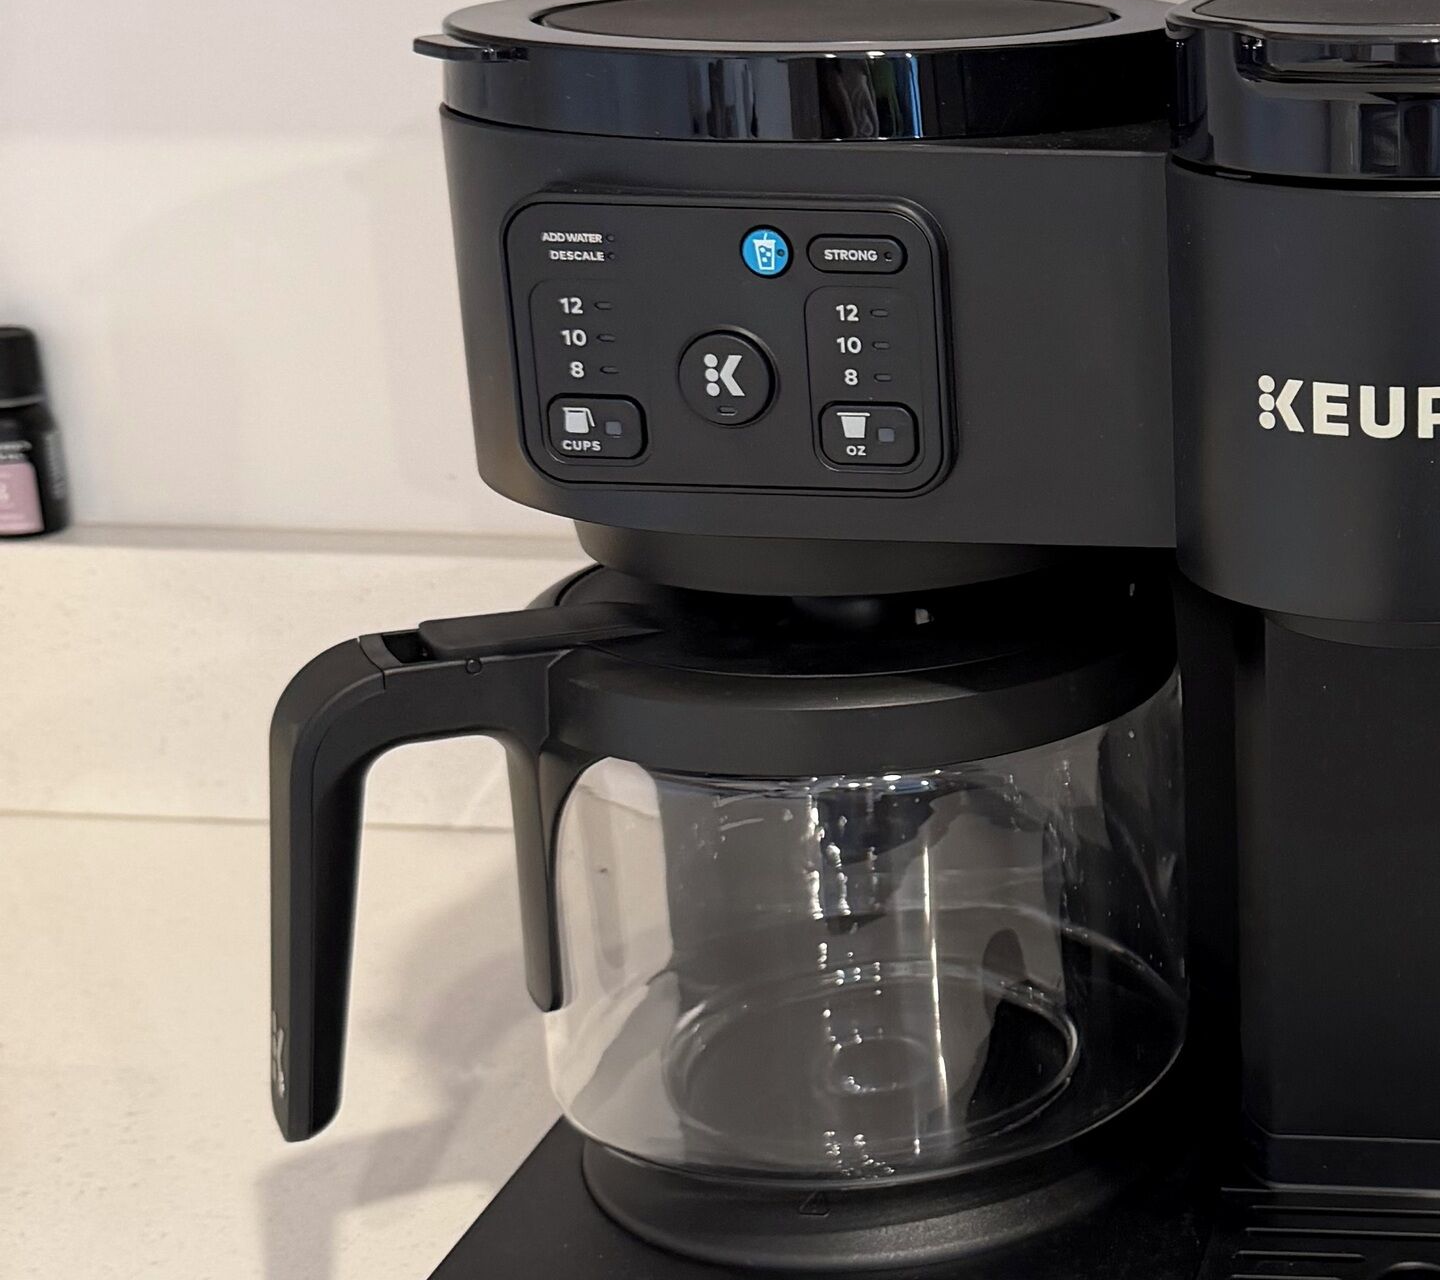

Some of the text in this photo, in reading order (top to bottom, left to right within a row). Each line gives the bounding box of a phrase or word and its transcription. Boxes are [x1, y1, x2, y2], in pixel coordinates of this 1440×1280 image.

[565, 233, 603, 244] WATER
[550, 250, 605, 261] DESCALE
[823, 249, 878, 262] STRONG
[559, 297, 584, 314] 12
[835, 304, 859, 322] 12
[561, 330, 587, 347] 10
[837, 337, 862, 354] 10
[570, 362, 584, 378] 8
[844, 368, 858, 386] 8
[562, 440, 601, 452] CUPS
[846, 446, 867, 457] OZ
